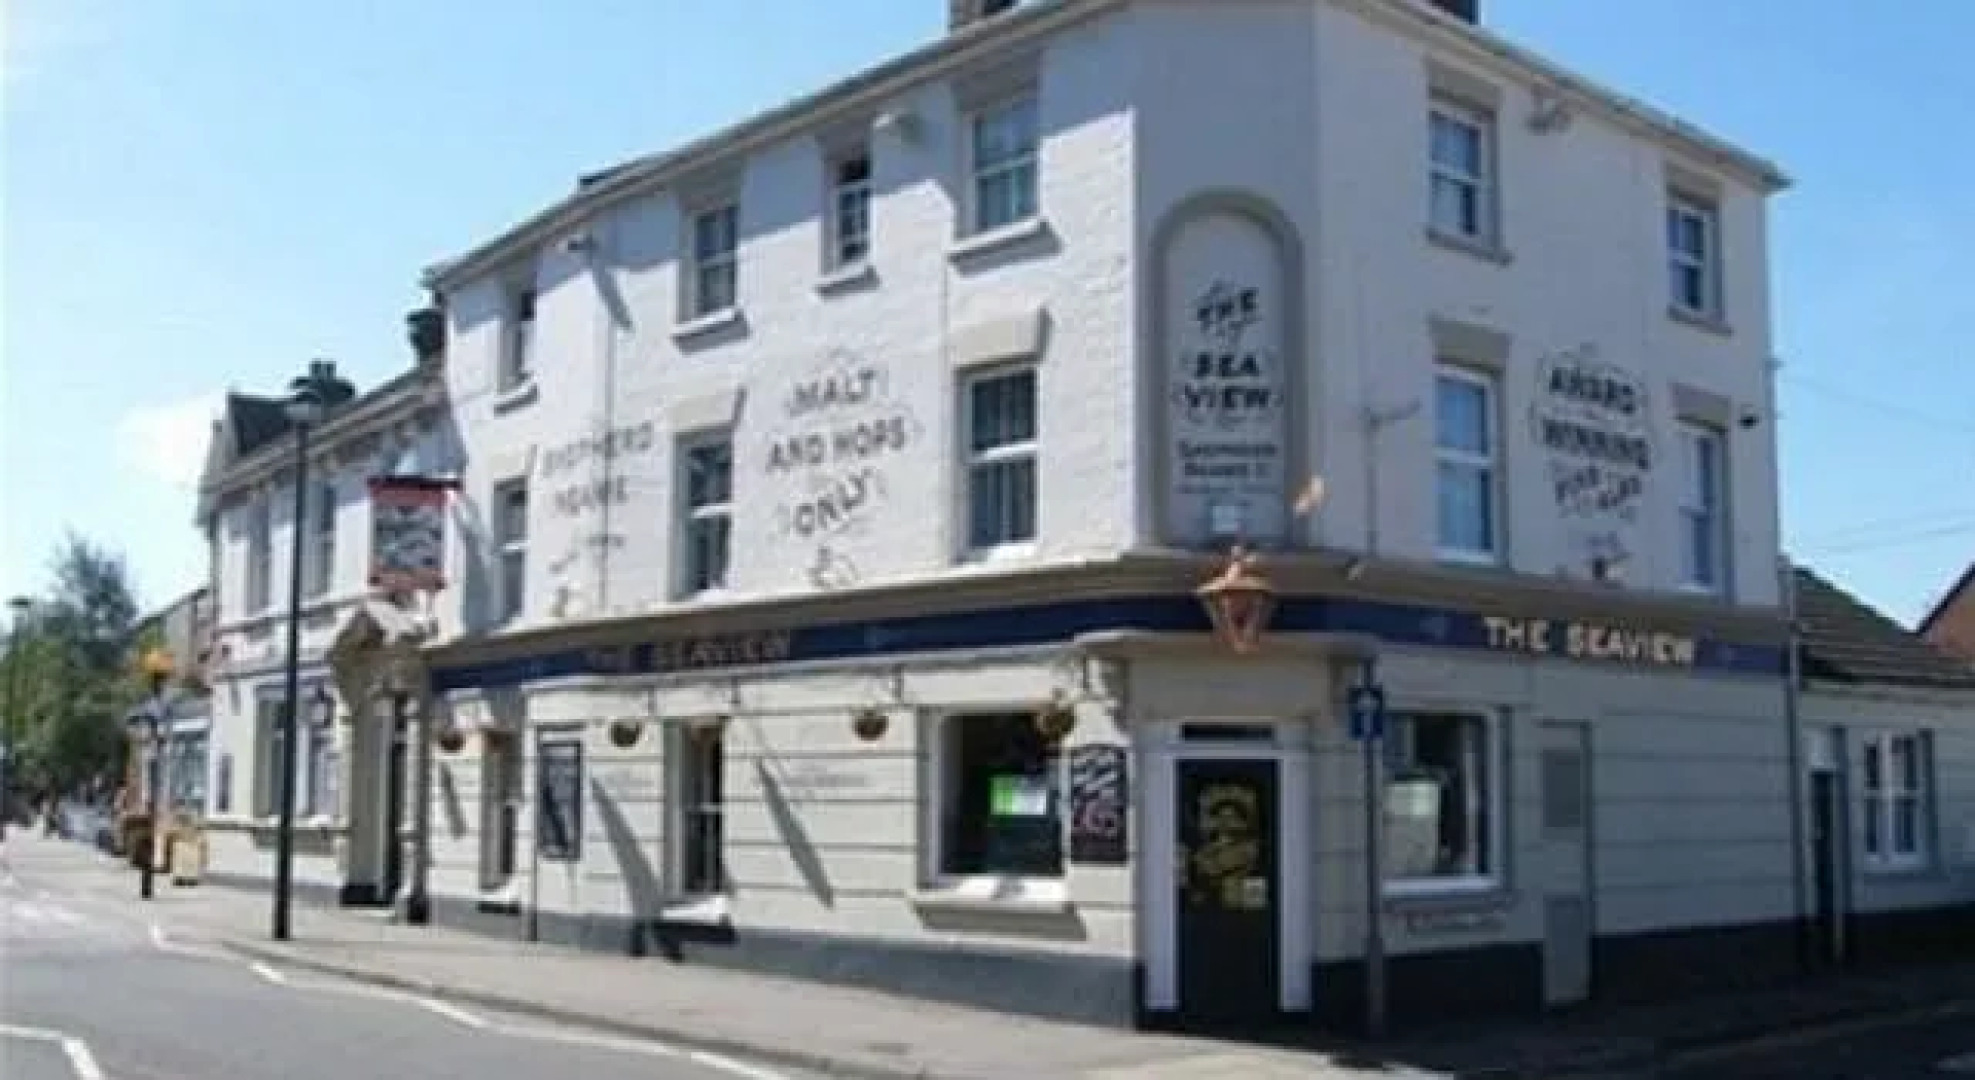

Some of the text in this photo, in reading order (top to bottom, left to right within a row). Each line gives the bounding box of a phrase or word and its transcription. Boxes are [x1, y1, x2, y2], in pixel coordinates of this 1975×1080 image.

[1196, 286, 1259, 331] THE
[1195, 353, 1260, 377] SEA
[789, 370, 875, 414] MALT
[1185, 385, 1271, 409] VIEW
[767, 416, 906, 472] AND HOPS
[794, 468, 873, 538] ONLY
[1483, 615, 1696, 663] THE SEAVIEW
